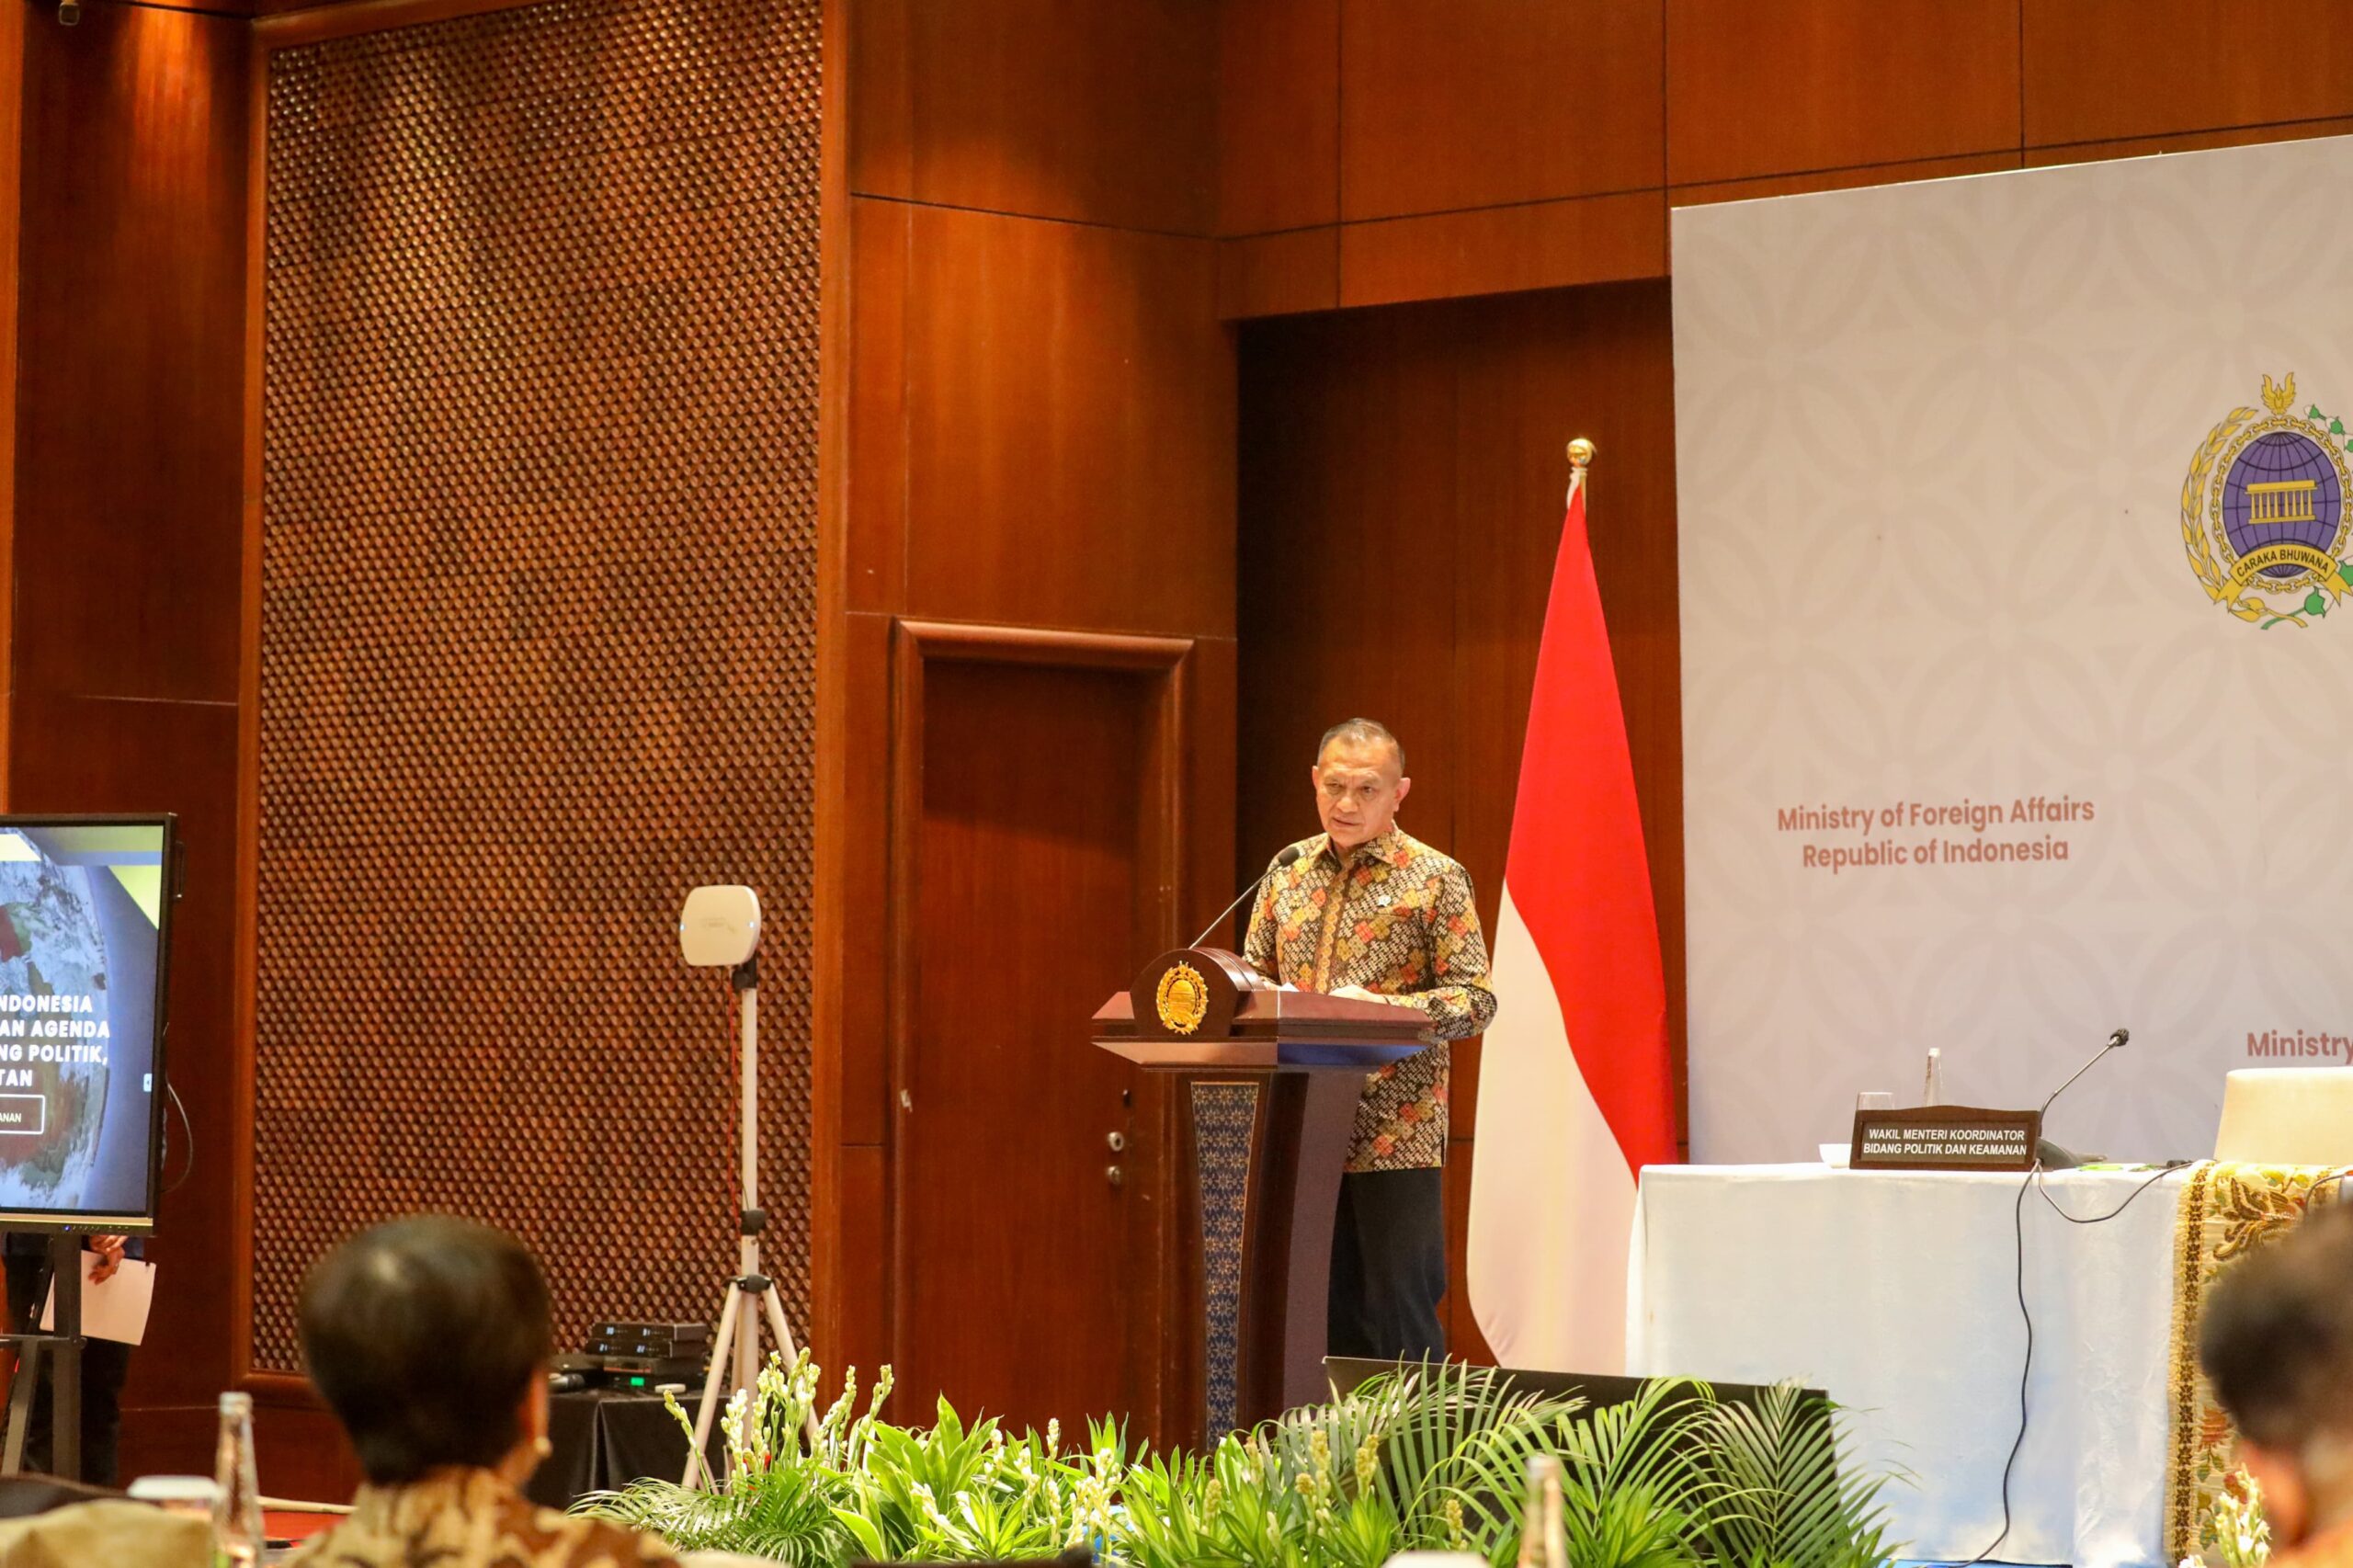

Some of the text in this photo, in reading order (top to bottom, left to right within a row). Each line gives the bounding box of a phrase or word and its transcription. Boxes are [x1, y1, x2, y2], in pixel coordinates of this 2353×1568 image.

[2236, 549, 2329, 577] CARAKA BHUWANA
[1778, 795, 2096, 836] Ministry of Foreign Affairs
[1802, 835, 2069, 875] Republic of Indonesia
[30, 1019, 110, 1038] AGENDA
[28, 1044, 108, 1066] POLITIK,
[2247, 1028, 2353, 1065] Ministry
[1869, 1129, 2025, 1141] WAKIL MENTERI KOORDINATOR
[1863, 1143, 2028, 1155] BIDANG POLITIK DAN KEAMANAN
